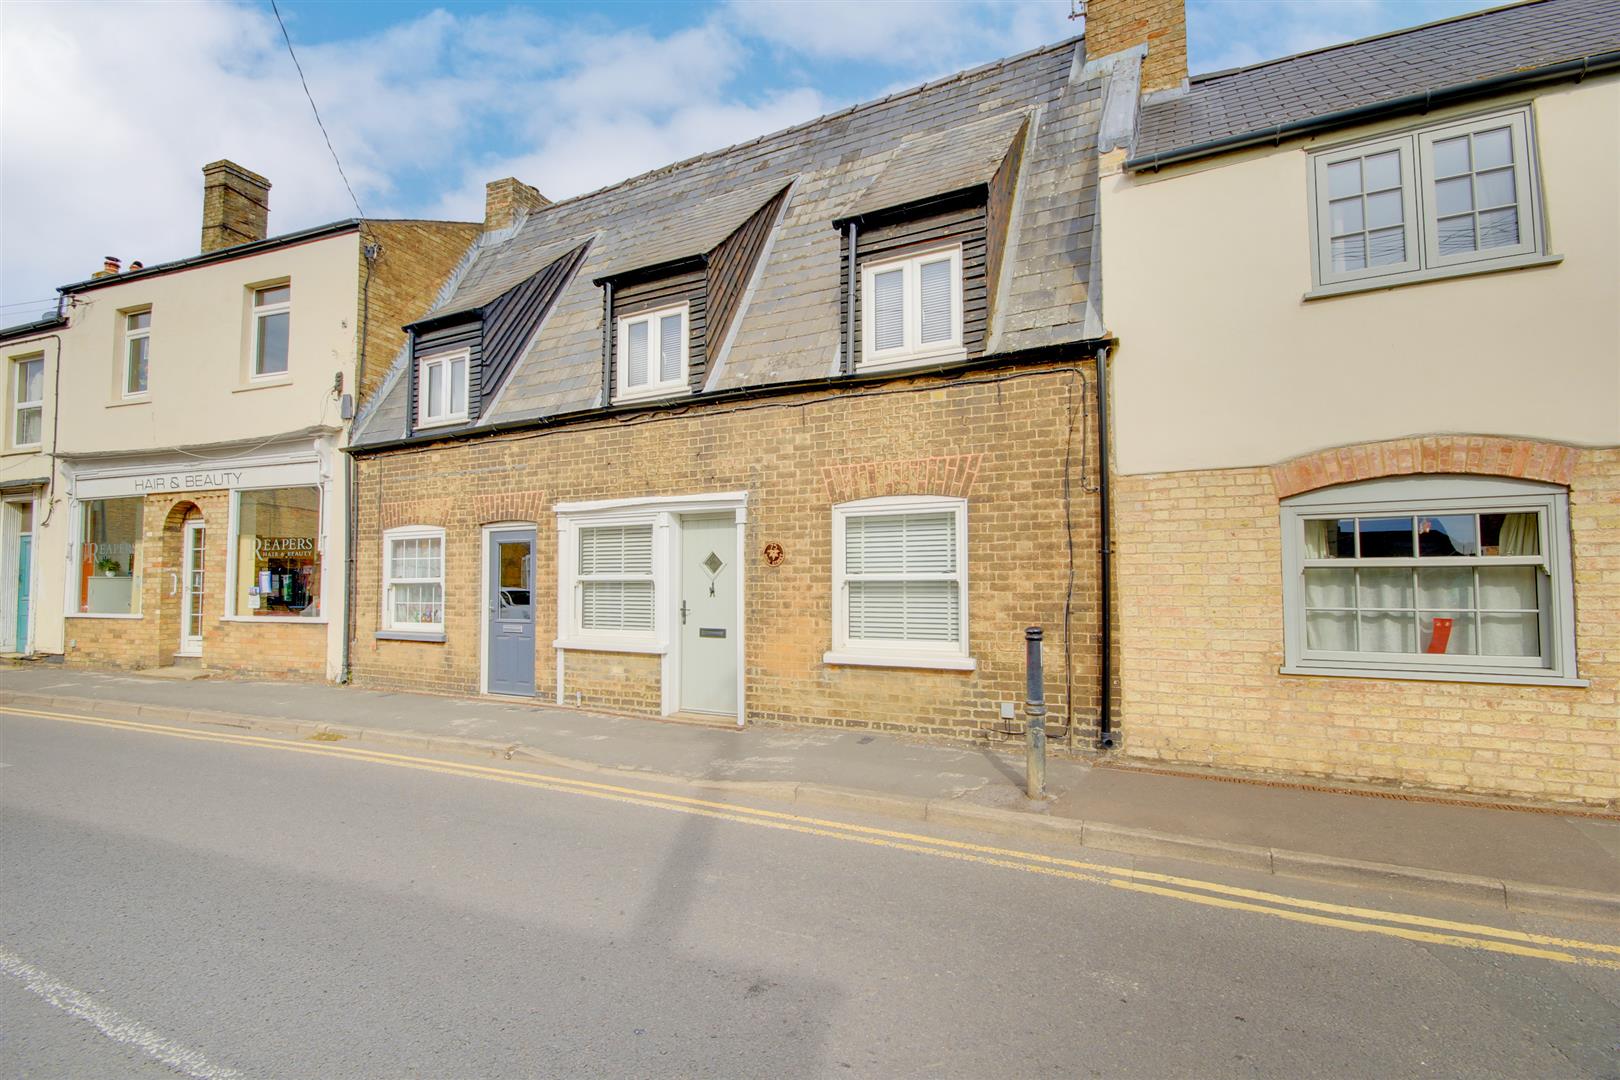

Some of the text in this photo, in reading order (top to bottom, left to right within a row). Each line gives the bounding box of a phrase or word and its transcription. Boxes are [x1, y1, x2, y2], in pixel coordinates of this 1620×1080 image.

[134, 472, 243, 492] HAIR & BEAUTY
[251, 537, 313, 561] REAPERS
